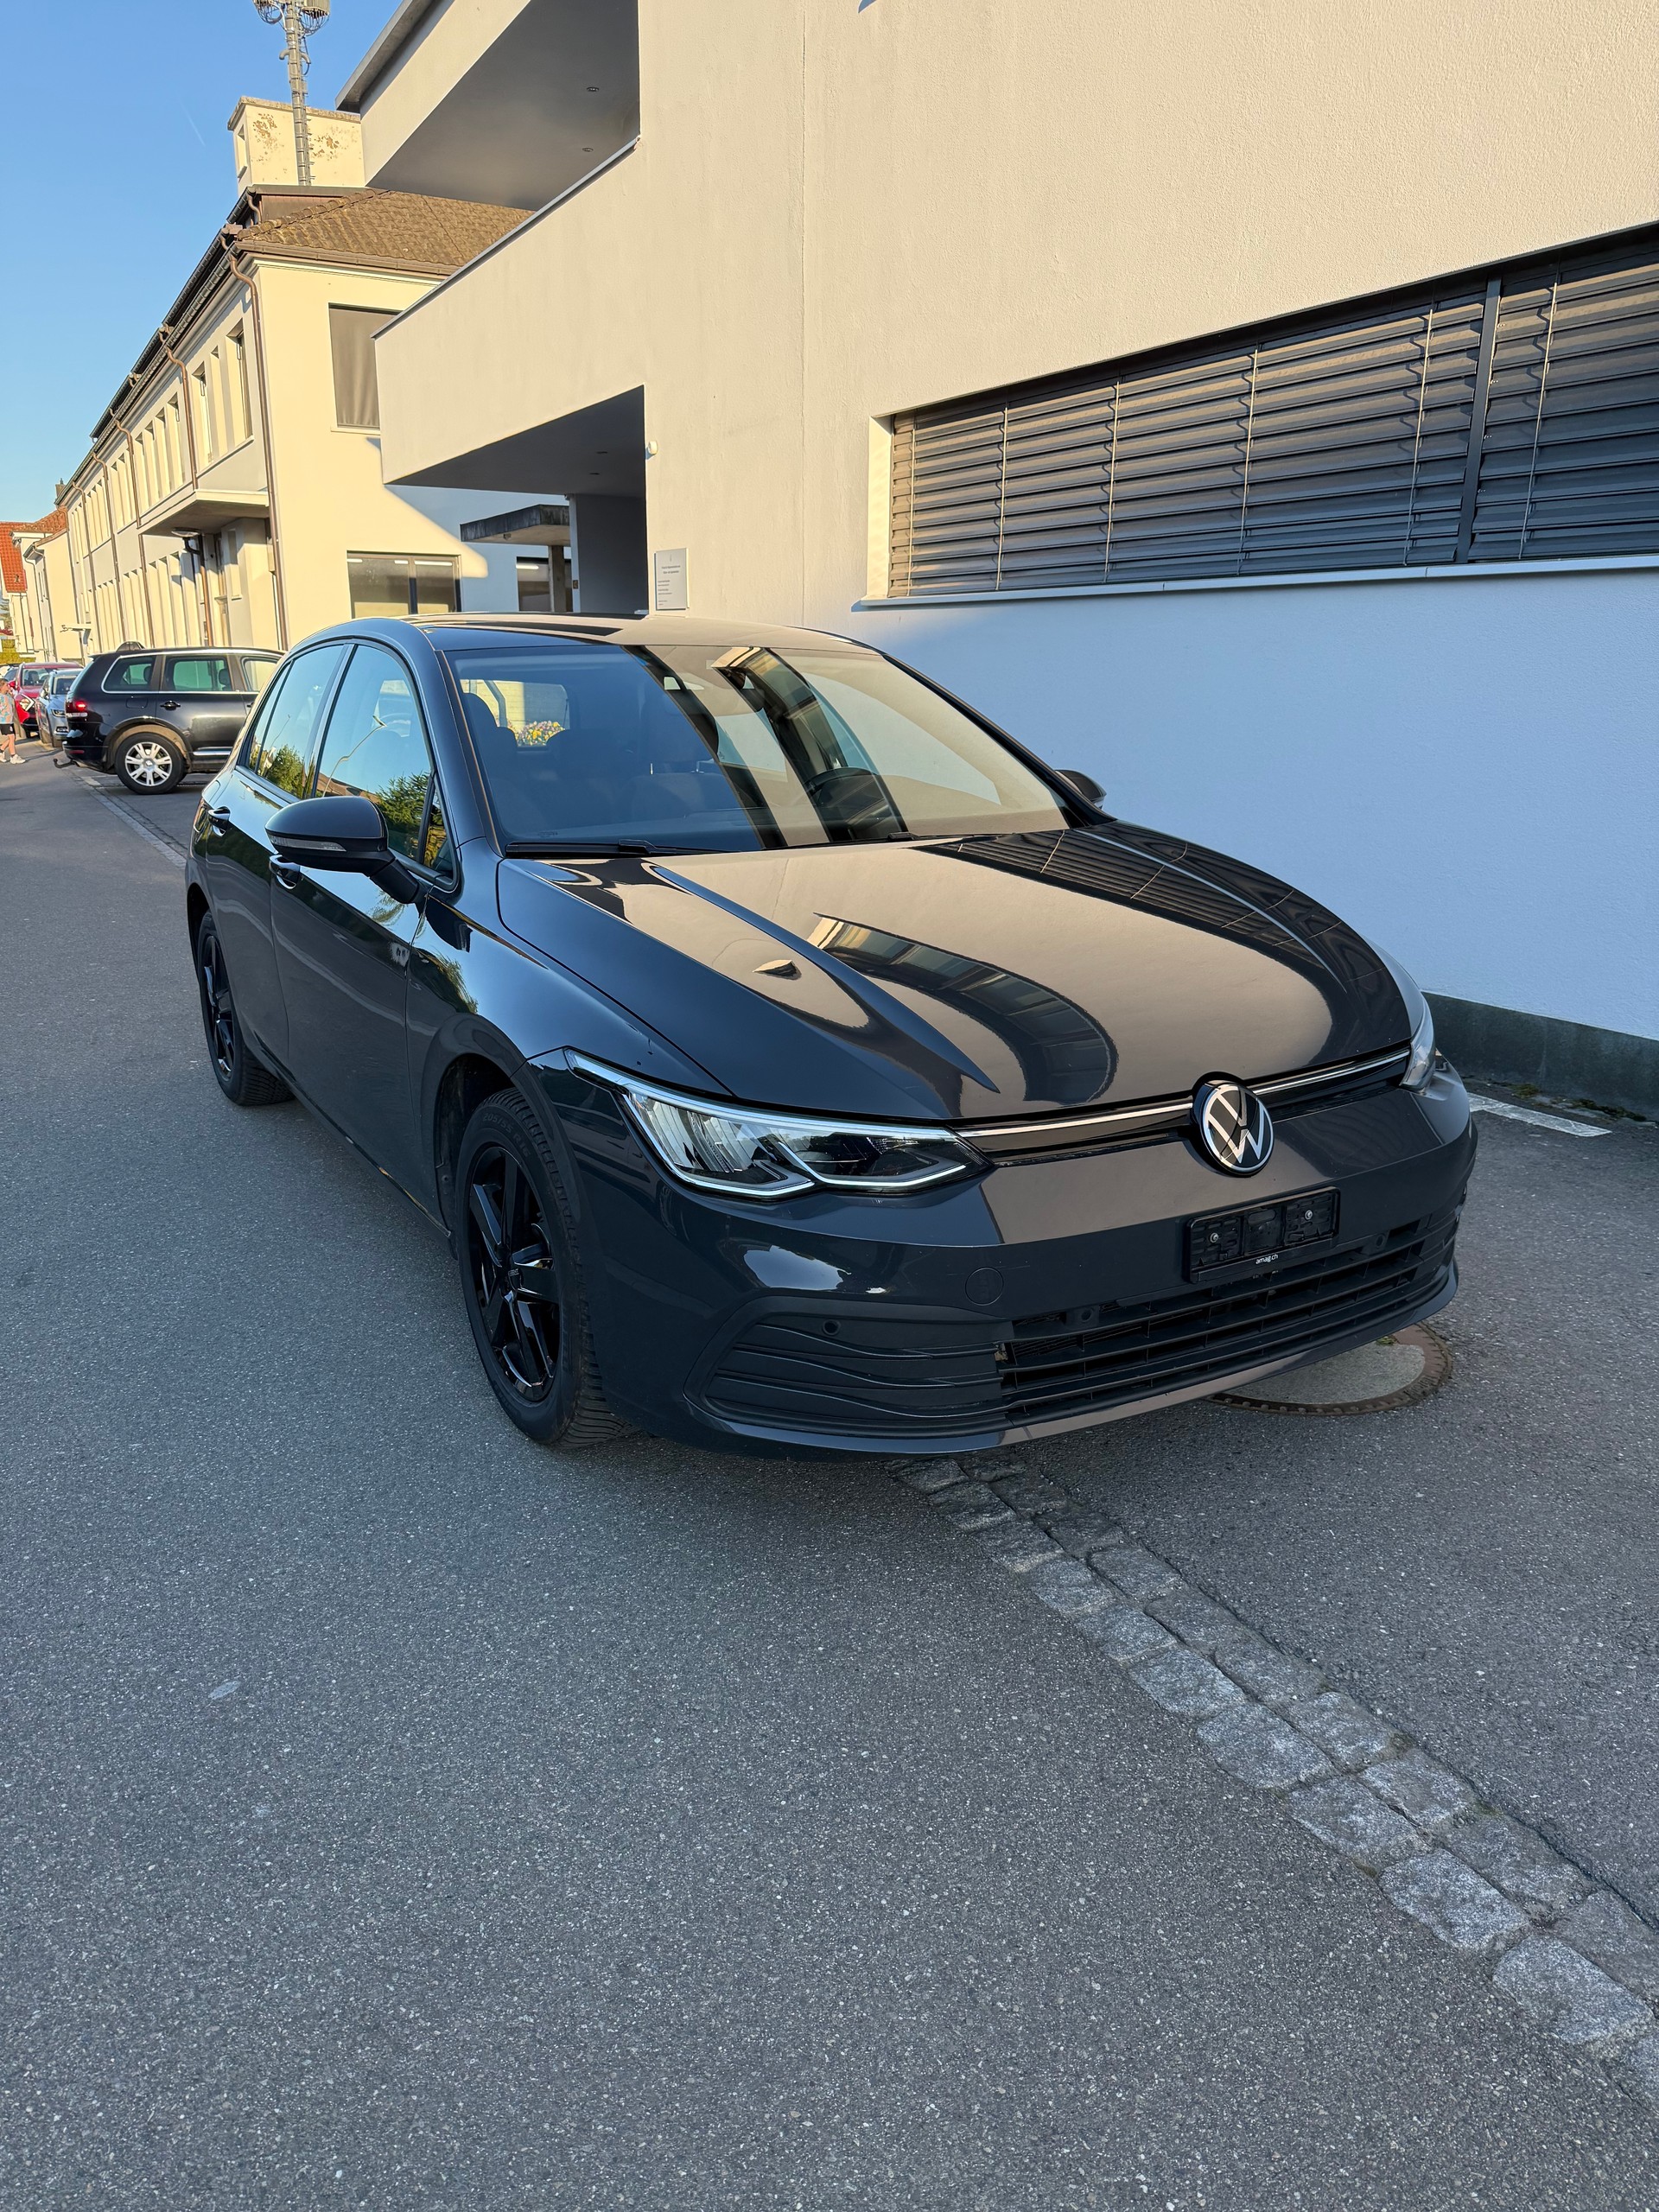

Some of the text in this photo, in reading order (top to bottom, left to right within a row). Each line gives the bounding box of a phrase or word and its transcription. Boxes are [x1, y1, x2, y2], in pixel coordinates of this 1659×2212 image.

[482, 1112, 513, 1134] 205/55
[1204, 1084, 1273, 1170] VW
[1255, 1253, 1279, 1265] amag.ch
